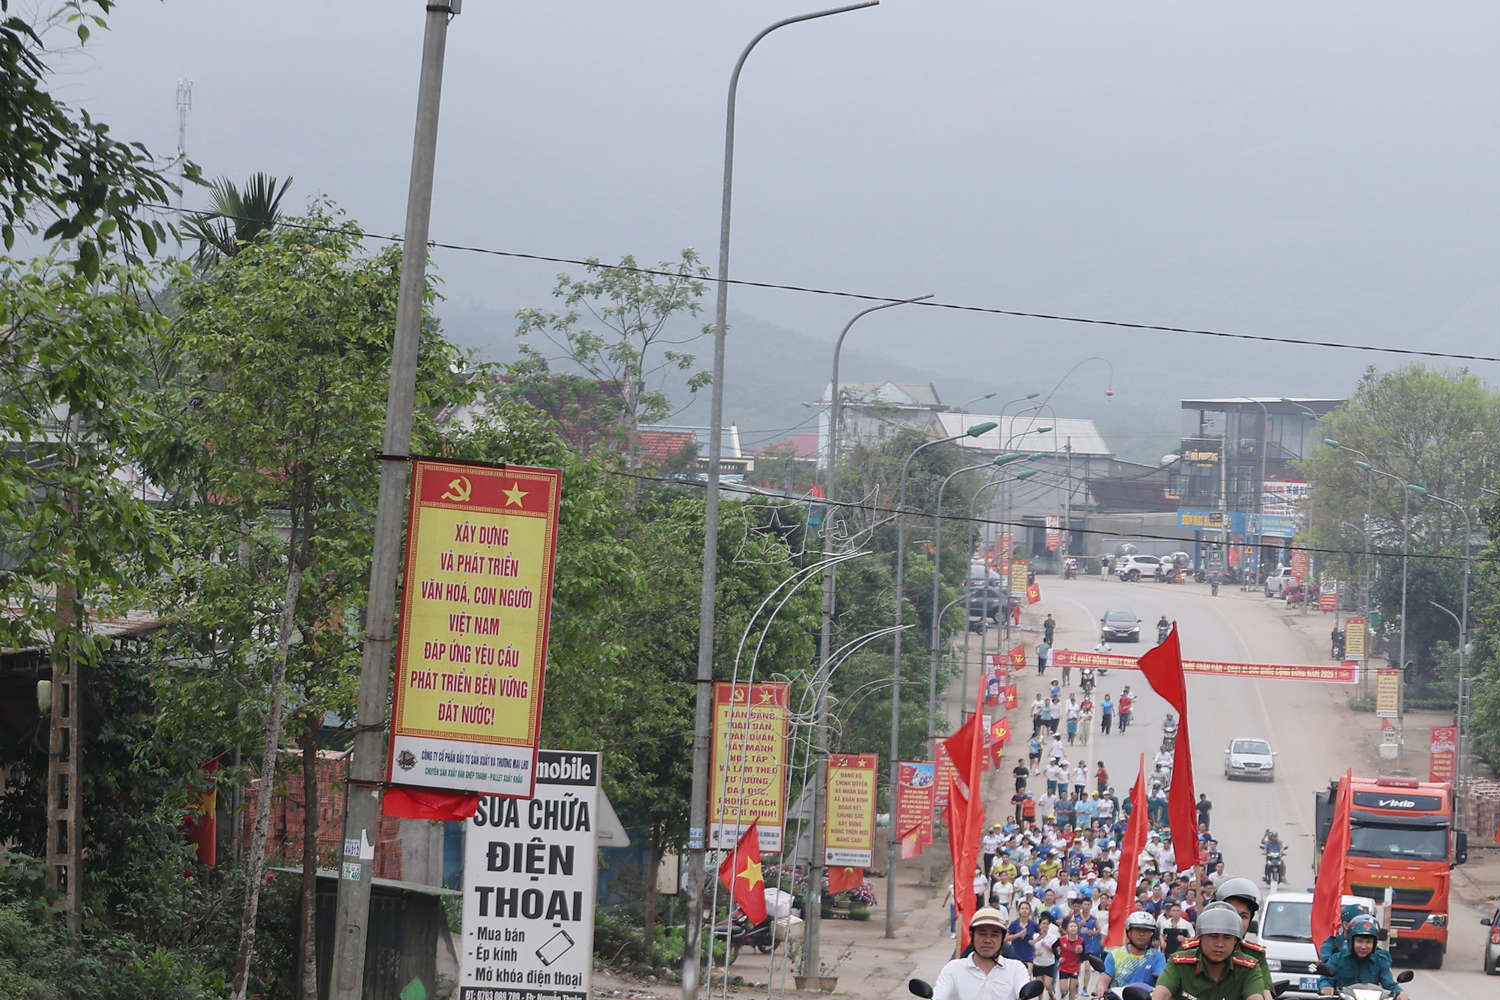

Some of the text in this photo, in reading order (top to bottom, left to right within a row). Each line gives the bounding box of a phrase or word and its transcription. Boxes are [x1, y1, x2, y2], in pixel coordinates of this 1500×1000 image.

[455, 520, 509, 549] XÂY DỰNG
[441, 550, 519, 578] VÀ PHÁT TRIỂN
[421, 580, 533, 609] VĂN HOÁ, CON NGƯỜI
[449, 613, 500, 637] VIỆT NAM
[424, 641, 519, 668] ĐÁP ỨNG YÊU CẦU
[410, 667, 528, 699] PHÁT TRIỂN BỀN VỮNG
[438, 699, 495, 726] ĐẤT NƯỚC!
[422, 749, 432, 760] CÔNG
[747, 744, 773, 753] MẠNH
[751, 755, 767, 764] TẬP
[537, 756, 591, 781] mobile
[528, 792, 591, 832] CHỮA
[753, 798, 776, 806] CÁCH
[486, 837, 574, 881] ĐIỆN
[475, 886, 583, 928] THOẠI
[477, 927, 525, 943] Mua bán
[476, 946, 517, 963] Ép kính
[475, 967, 582, 988] Mở khóa điện thoại
[466, 990, 476, 1000] ĐT:
